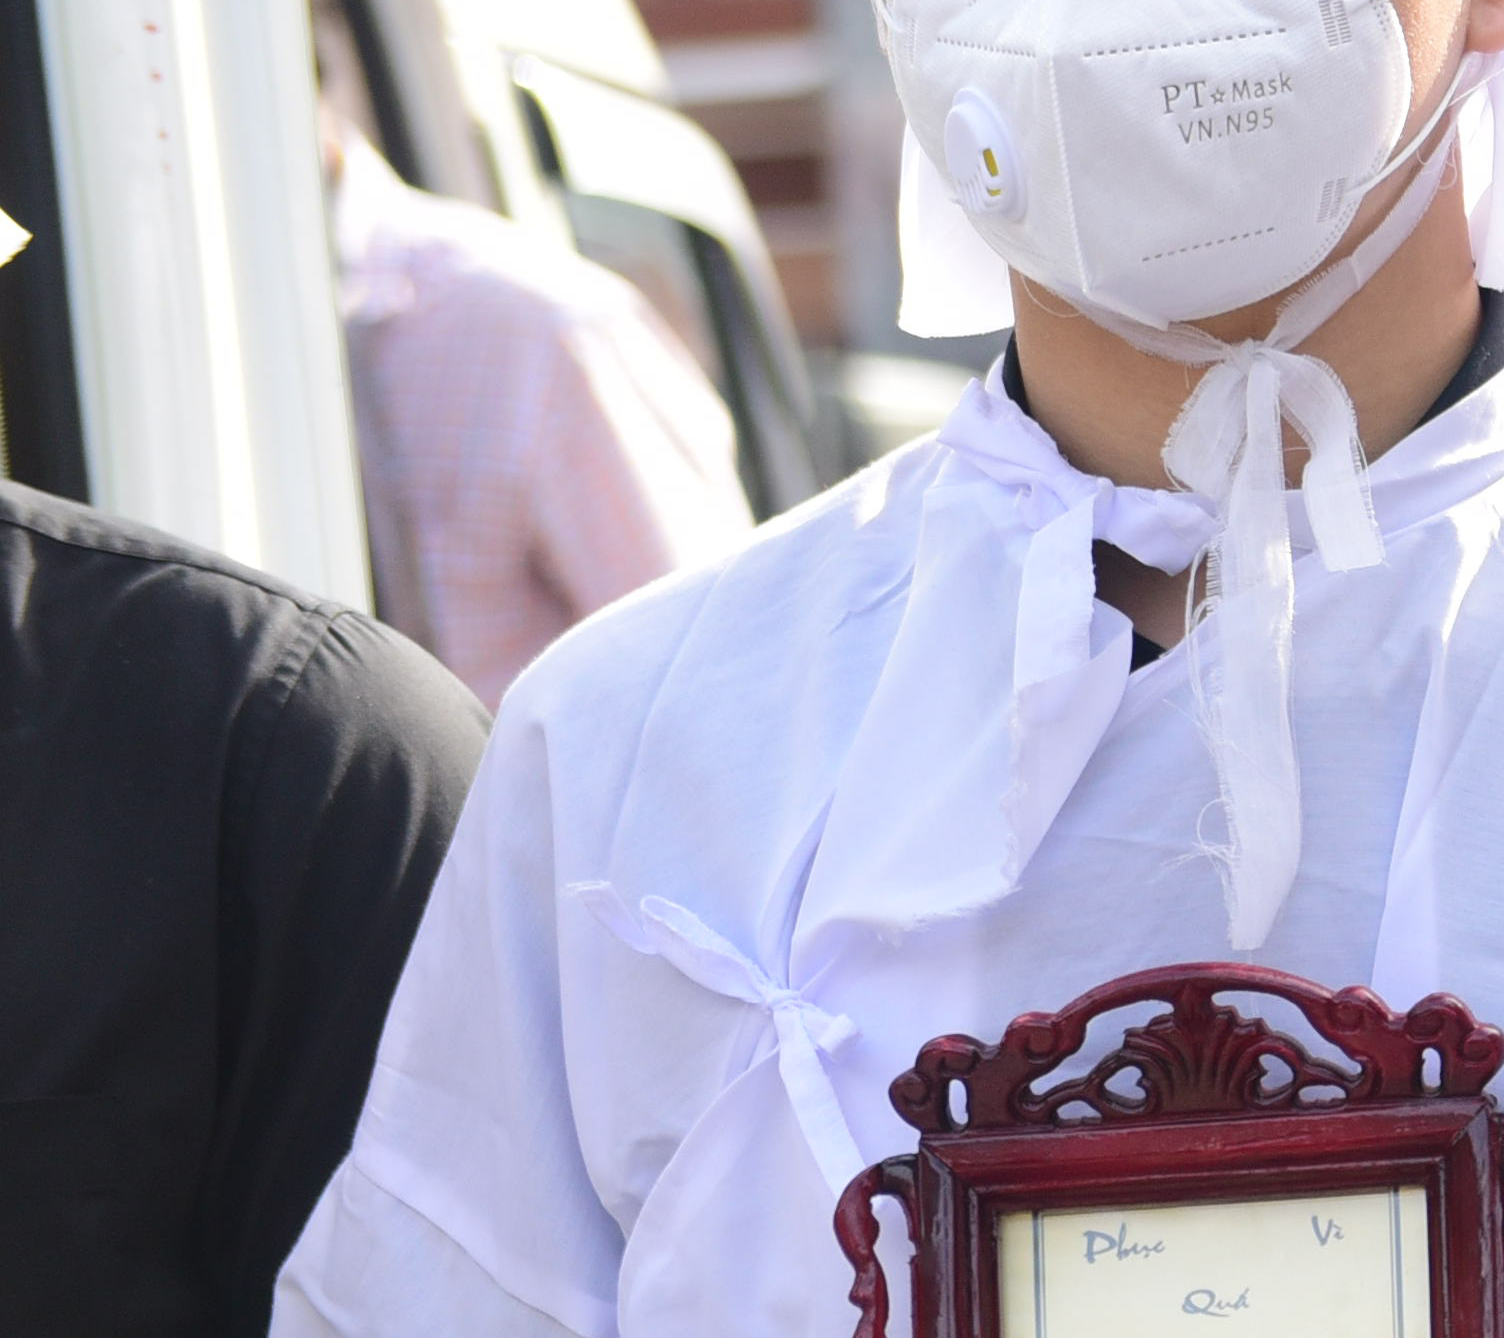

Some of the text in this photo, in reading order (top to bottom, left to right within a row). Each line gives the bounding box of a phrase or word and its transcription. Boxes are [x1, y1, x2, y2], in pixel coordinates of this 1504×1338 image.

[1161, 72, 1292, 114] PT Mask
[1178, 107, 1274, 144] VN.N95
[1084, 1224, 1165, 1264] Phục
[1182, 1288, 1249, 1317] Quá
